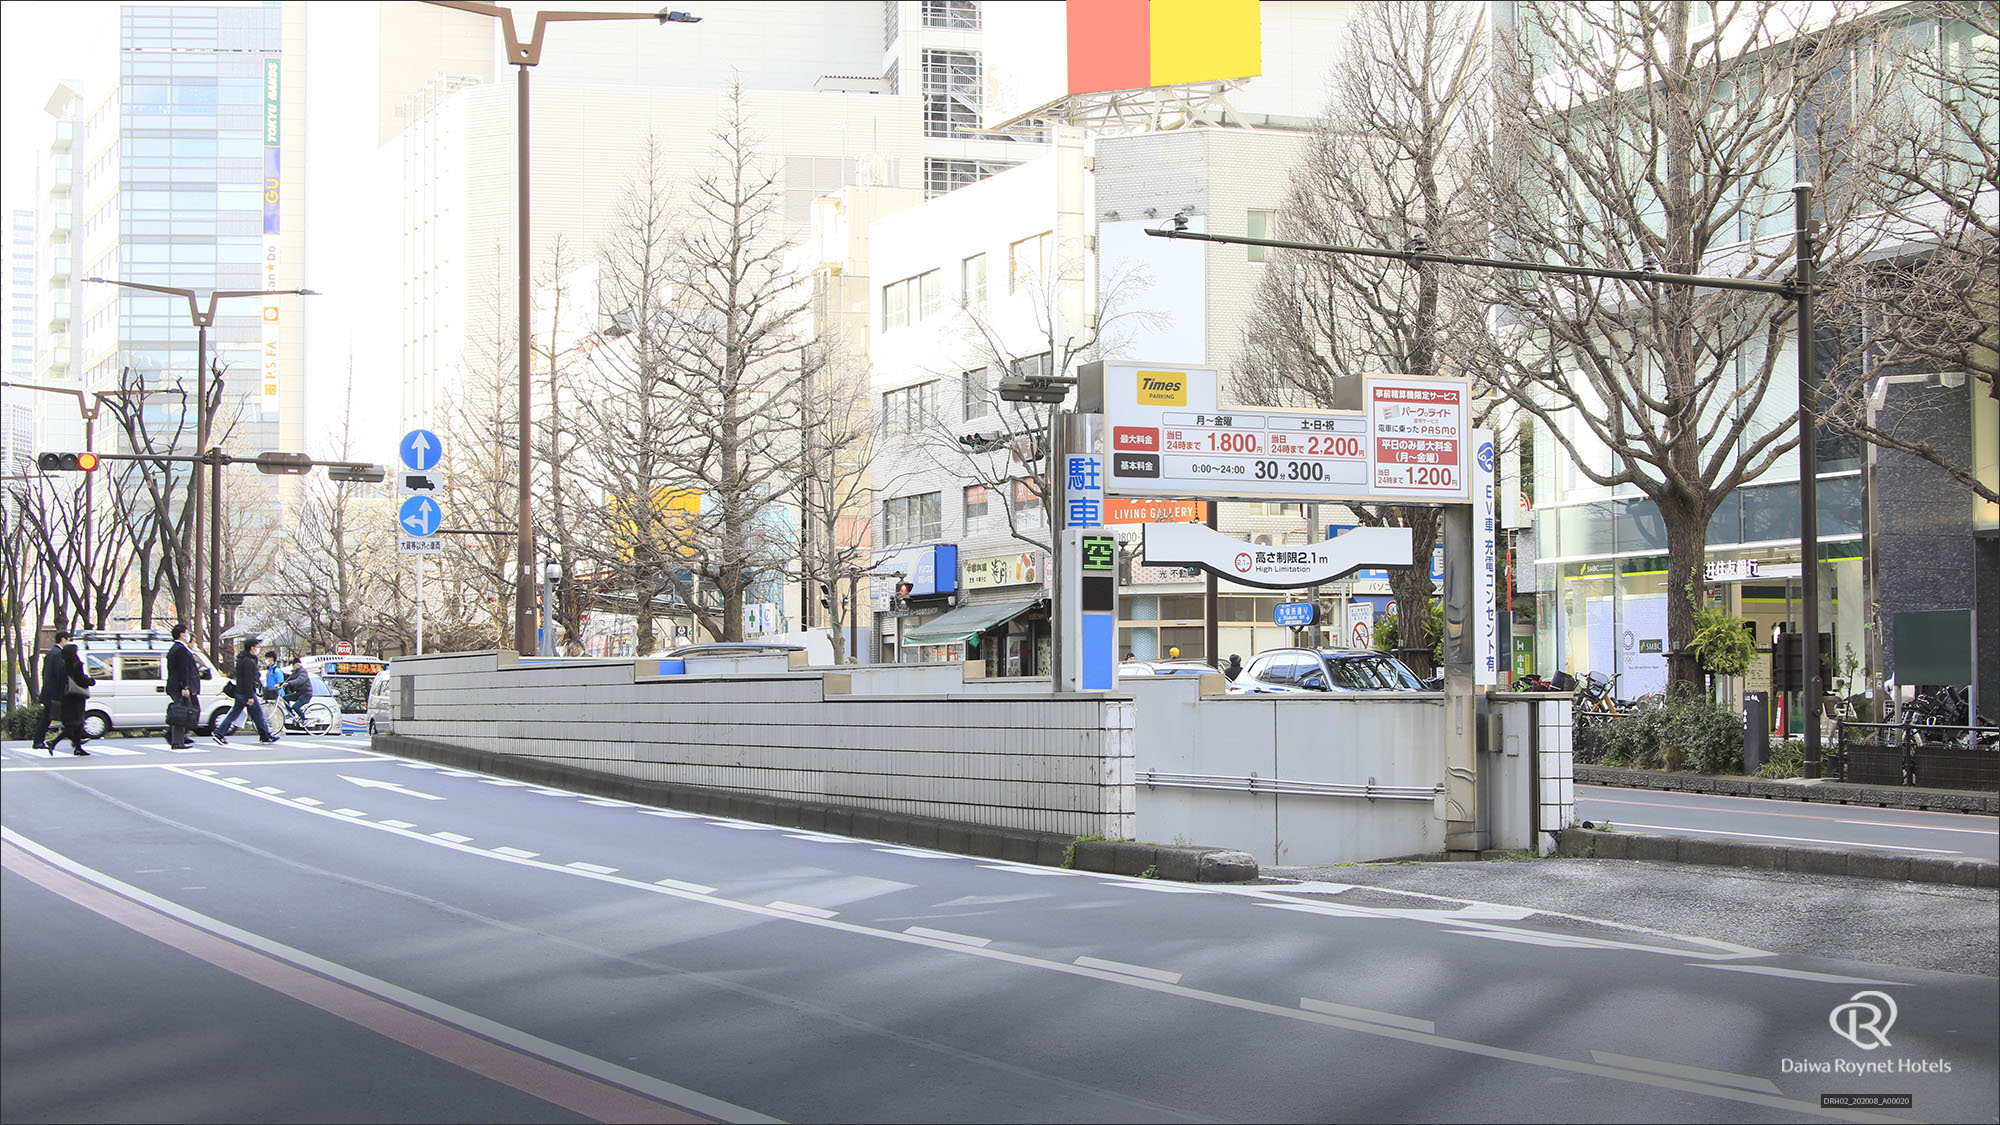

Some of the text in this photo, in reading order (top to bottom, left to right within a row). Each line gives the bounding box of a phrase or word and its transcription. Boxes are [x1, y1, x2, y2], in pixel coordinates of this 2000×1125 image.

[268, 62, 278, 143] TOKYU HANDS
[265, 178, 279, 204] GU
[1142, 378, 1182, 392] Times
[1166, 431, 1183, 440] 当日
[1421, 425, 1457, 435] PASMO
[1120, 434, 1153, 445] 最大料金
[1271, 434, 1287, 443] 当日
[1166, 440, 1201, 450] 24時まで
[1271, 444, 1305, 454] 24時まで
[1381, 439, 1453, 452] 平日のみ最大料金
[1120, 460, 1154, 471] 基本料金
[1378, 476, 1404, 485] 24時まで
[1114, 506, 1194, 520] LIVING GALLERY
[1083, 536, 1114, 569] 空
[1255, 551, 1328, 564] 高さ制限2.1m
[1274, 565, 1311, 573] Limitation
[1704, 559, 1759, 577] 井住友銀行
